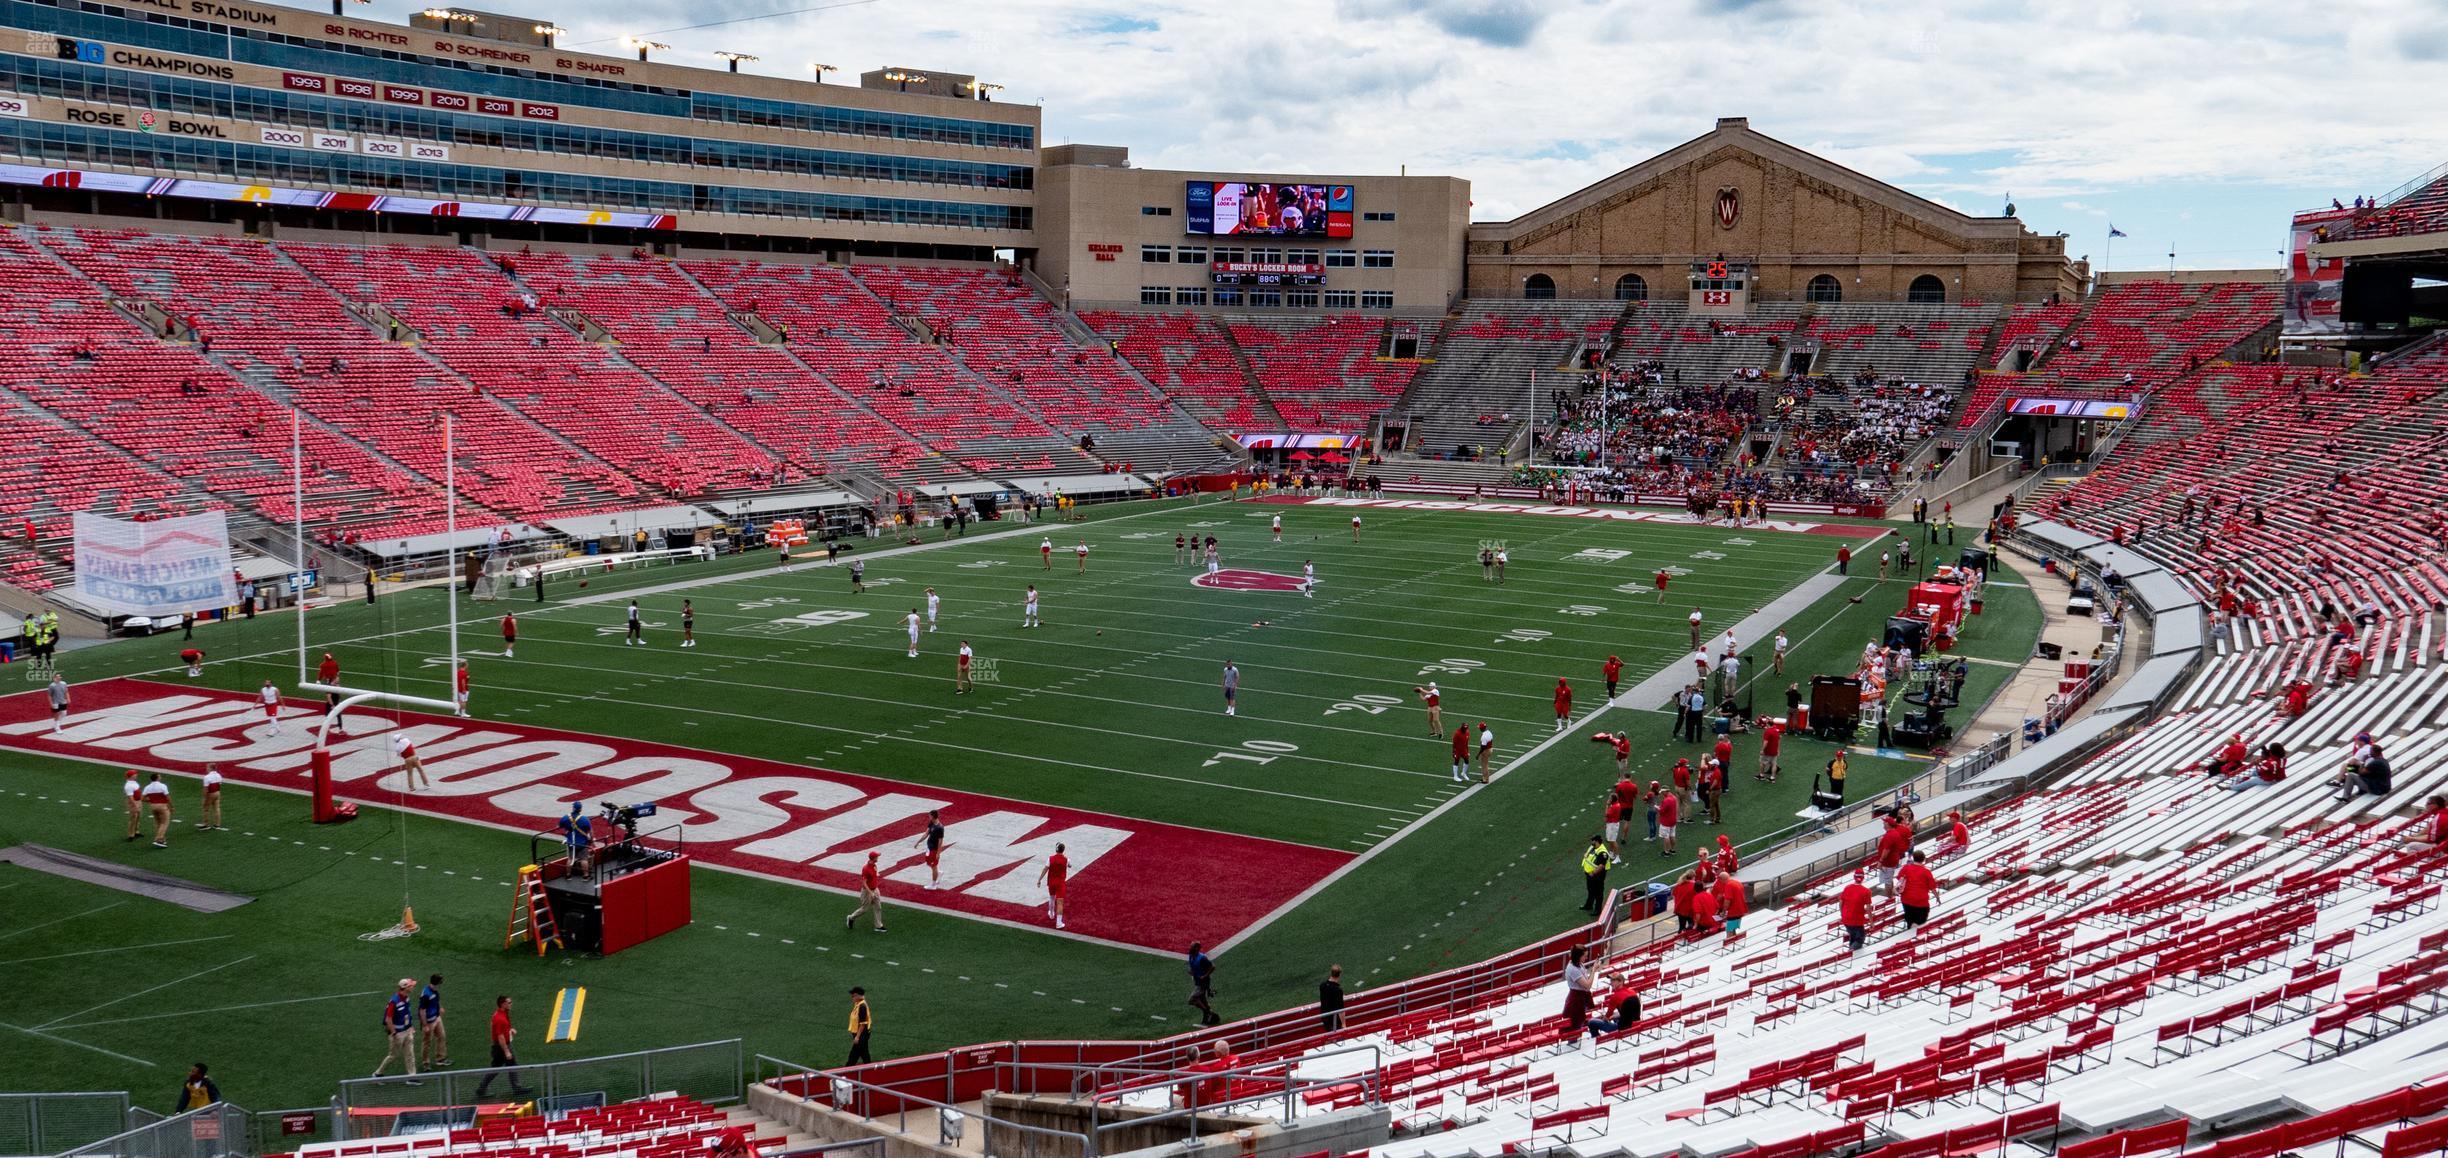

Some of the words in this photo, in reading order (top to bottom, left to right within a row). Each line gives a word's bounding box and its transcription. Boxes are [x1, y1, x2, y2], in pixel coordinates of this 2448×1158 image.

[191, 2, 277, 26] STADIUM
[325, 24, 344, 36] 88
[348, 28, 408, 46] RICHTER
[435, 41, 453, 53] 80
[457, 45, 530, 64] SCHREINER
[113, 51, 234, 79] CHAMPIONS
[556, 58, 573, 69] 83
[577, 61, 625, 76] SHAFER
[290, 76, 322, 89] 1993
[341, 83, 372, 96] 1998
[390, 89, 419, 102] 1999
[437, 95, 465, 108] 2010
[485, 101, 508, 113] 2011
[528, 106, 554, 118] 2012
[67, 108, 125, 126] ROSE
[168, 120, 226, 138] BOWL
[264, 132, 302, 144] 2000
[321, 137, 347, 149] 2011
[369, 142, 397, 155] 2012
[417, 147, 444, 159] 2013
[1720, 199, 1736, 221] W
[1229, 263, 1258, 272] BUCKY'S
[1259, 263, 1286, 273] LOCKER
[1287, 264, 1307, 273] ROOM
[1709, 262, 1727, 277] 25
[1505, 628, 1553, 643] 40
[1430, 657, 1486, 675] 30
[1340, 694, 1403, 715] 20
[1215, 739, 1299, 766] 10
